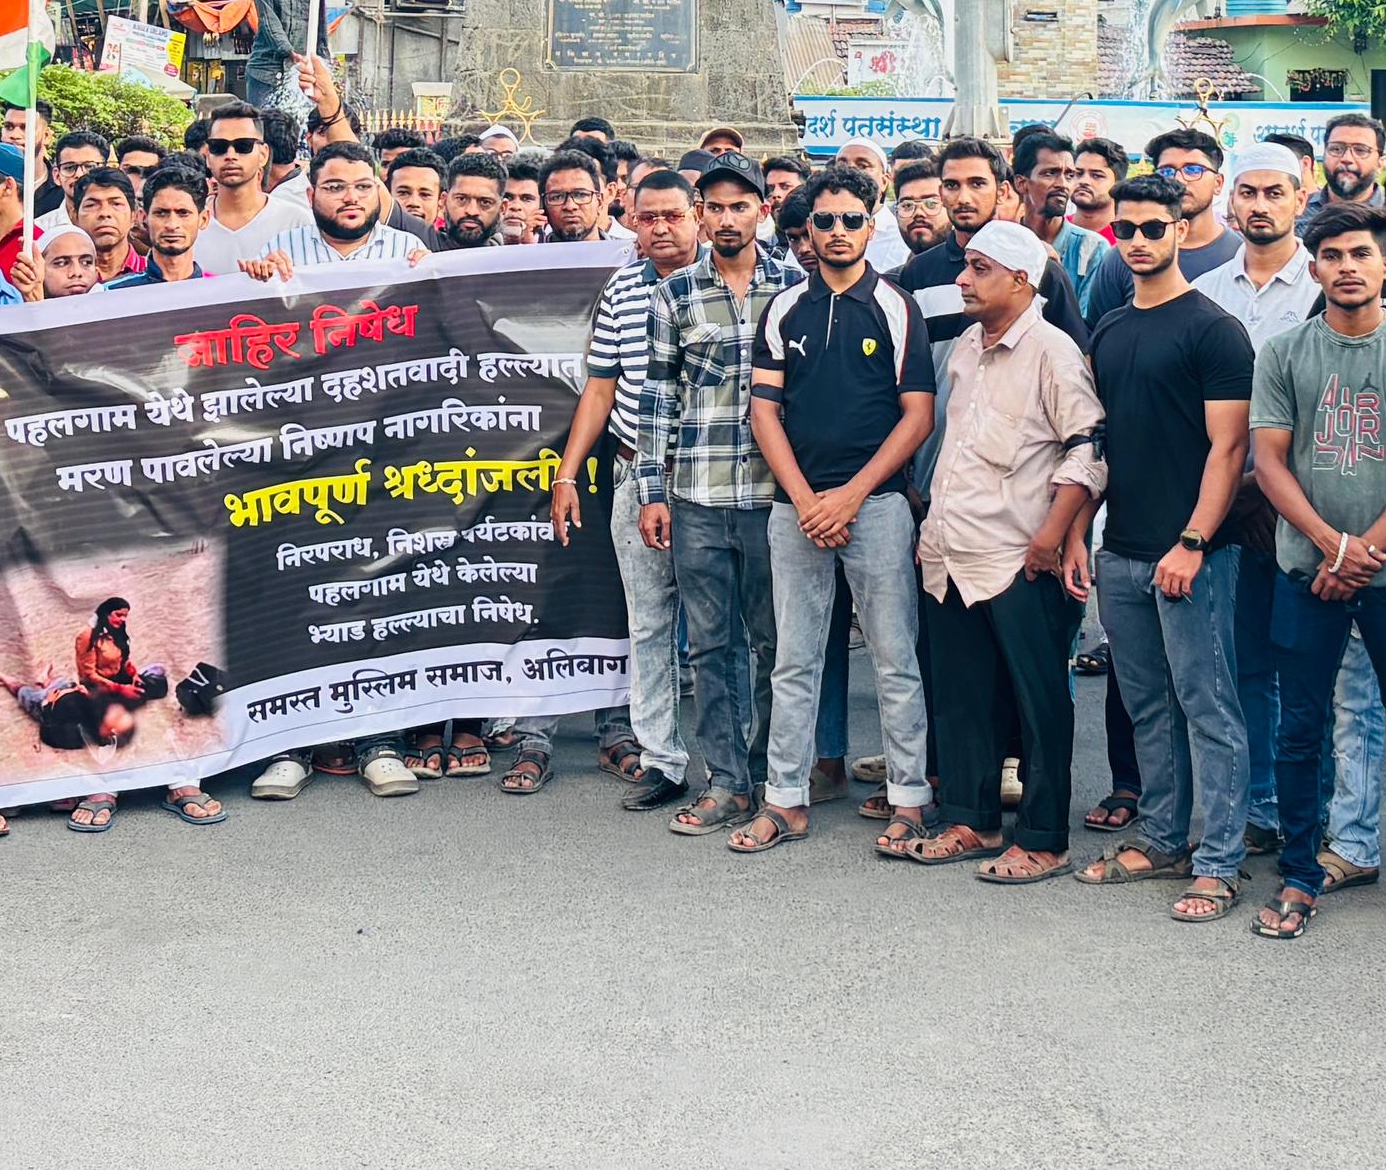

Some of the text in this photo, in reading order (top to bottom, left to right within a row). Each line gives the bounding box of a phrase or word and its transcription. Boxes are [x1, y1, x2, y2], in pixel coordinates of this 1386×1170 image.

[806, 109, 941, 139] दर्श पतसंस्था
[174, 299, 419, 370] जाहिर निषेध
[4, 347, 585, 447] पहलगाम येथे झालेल्या दहशतवादी हल्ल्यात
[1317, 373, 1381, 414] AIR
[56, 395, 542, 493] मरण पावलेल्या निष्पाप नागरिकांना
[223, 458, 372, 527] भावपूर्ण
[276, 536, 379, 571] निरपराध,
[461, 514, 570, 543] पर्यटकांव
[309, 556, 538, 606] पहलगाम येथे केलेल्या
[309, 596, 540, 643] भ्याड हल्ल्याचा निषेध.
[247, 648, 629, 723] समस्त मुस्लिम समाज, अलिबाग
